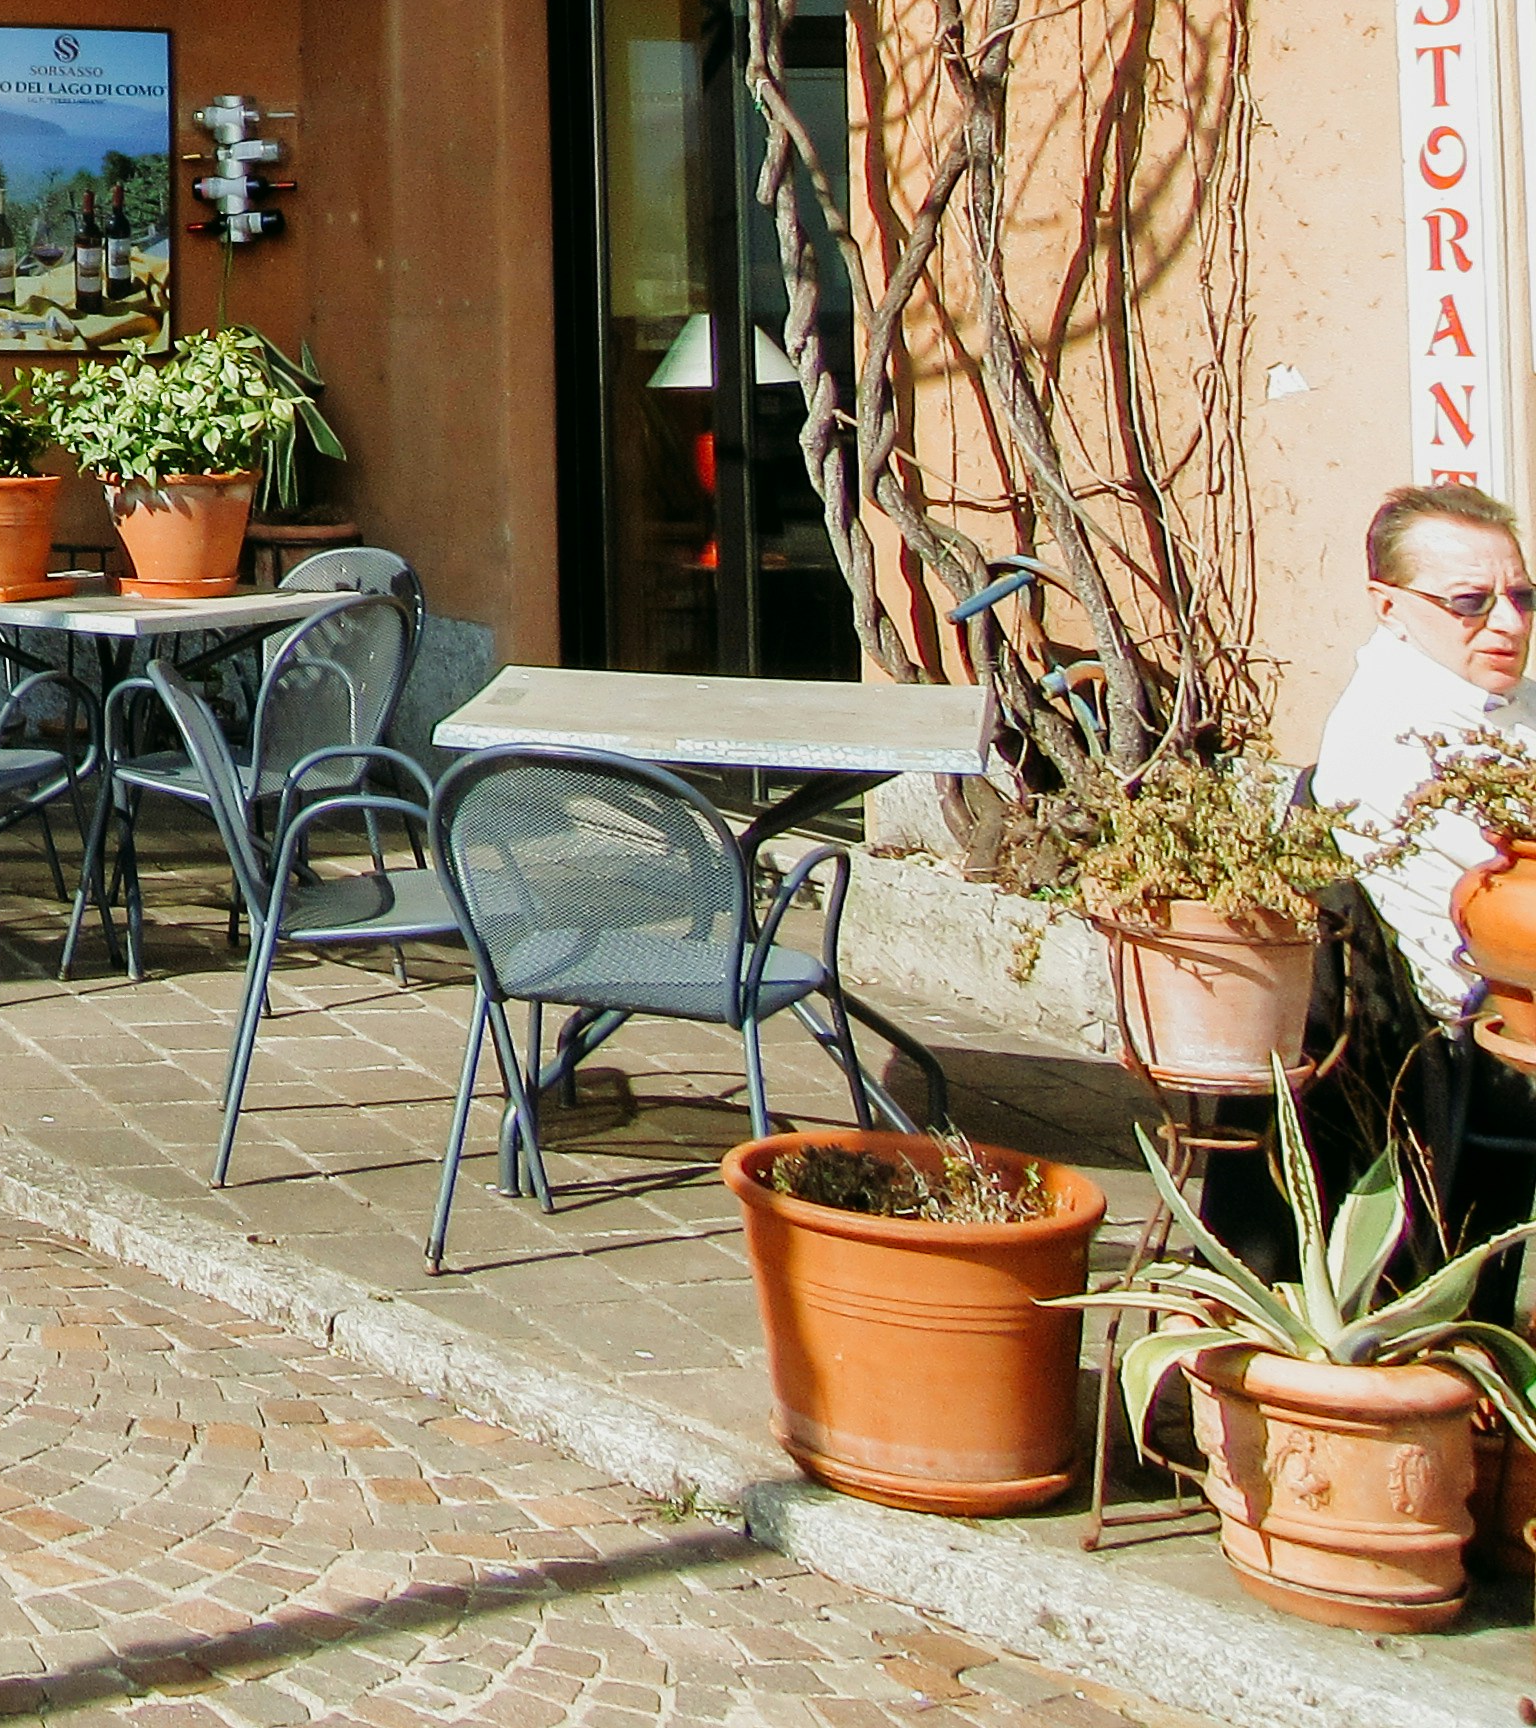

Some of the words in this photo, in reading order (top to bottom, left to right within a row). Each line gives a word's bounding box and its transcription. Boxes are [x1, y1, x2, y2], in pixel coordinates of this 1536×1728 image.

[29, 65, 104, 78] SORSASSO
[15, 81, 45, 94] DEL
[48, 82, 92, 96] LAGO
[96, 84, 112, 96] DI
[115, 84, 165, 97] COMO
